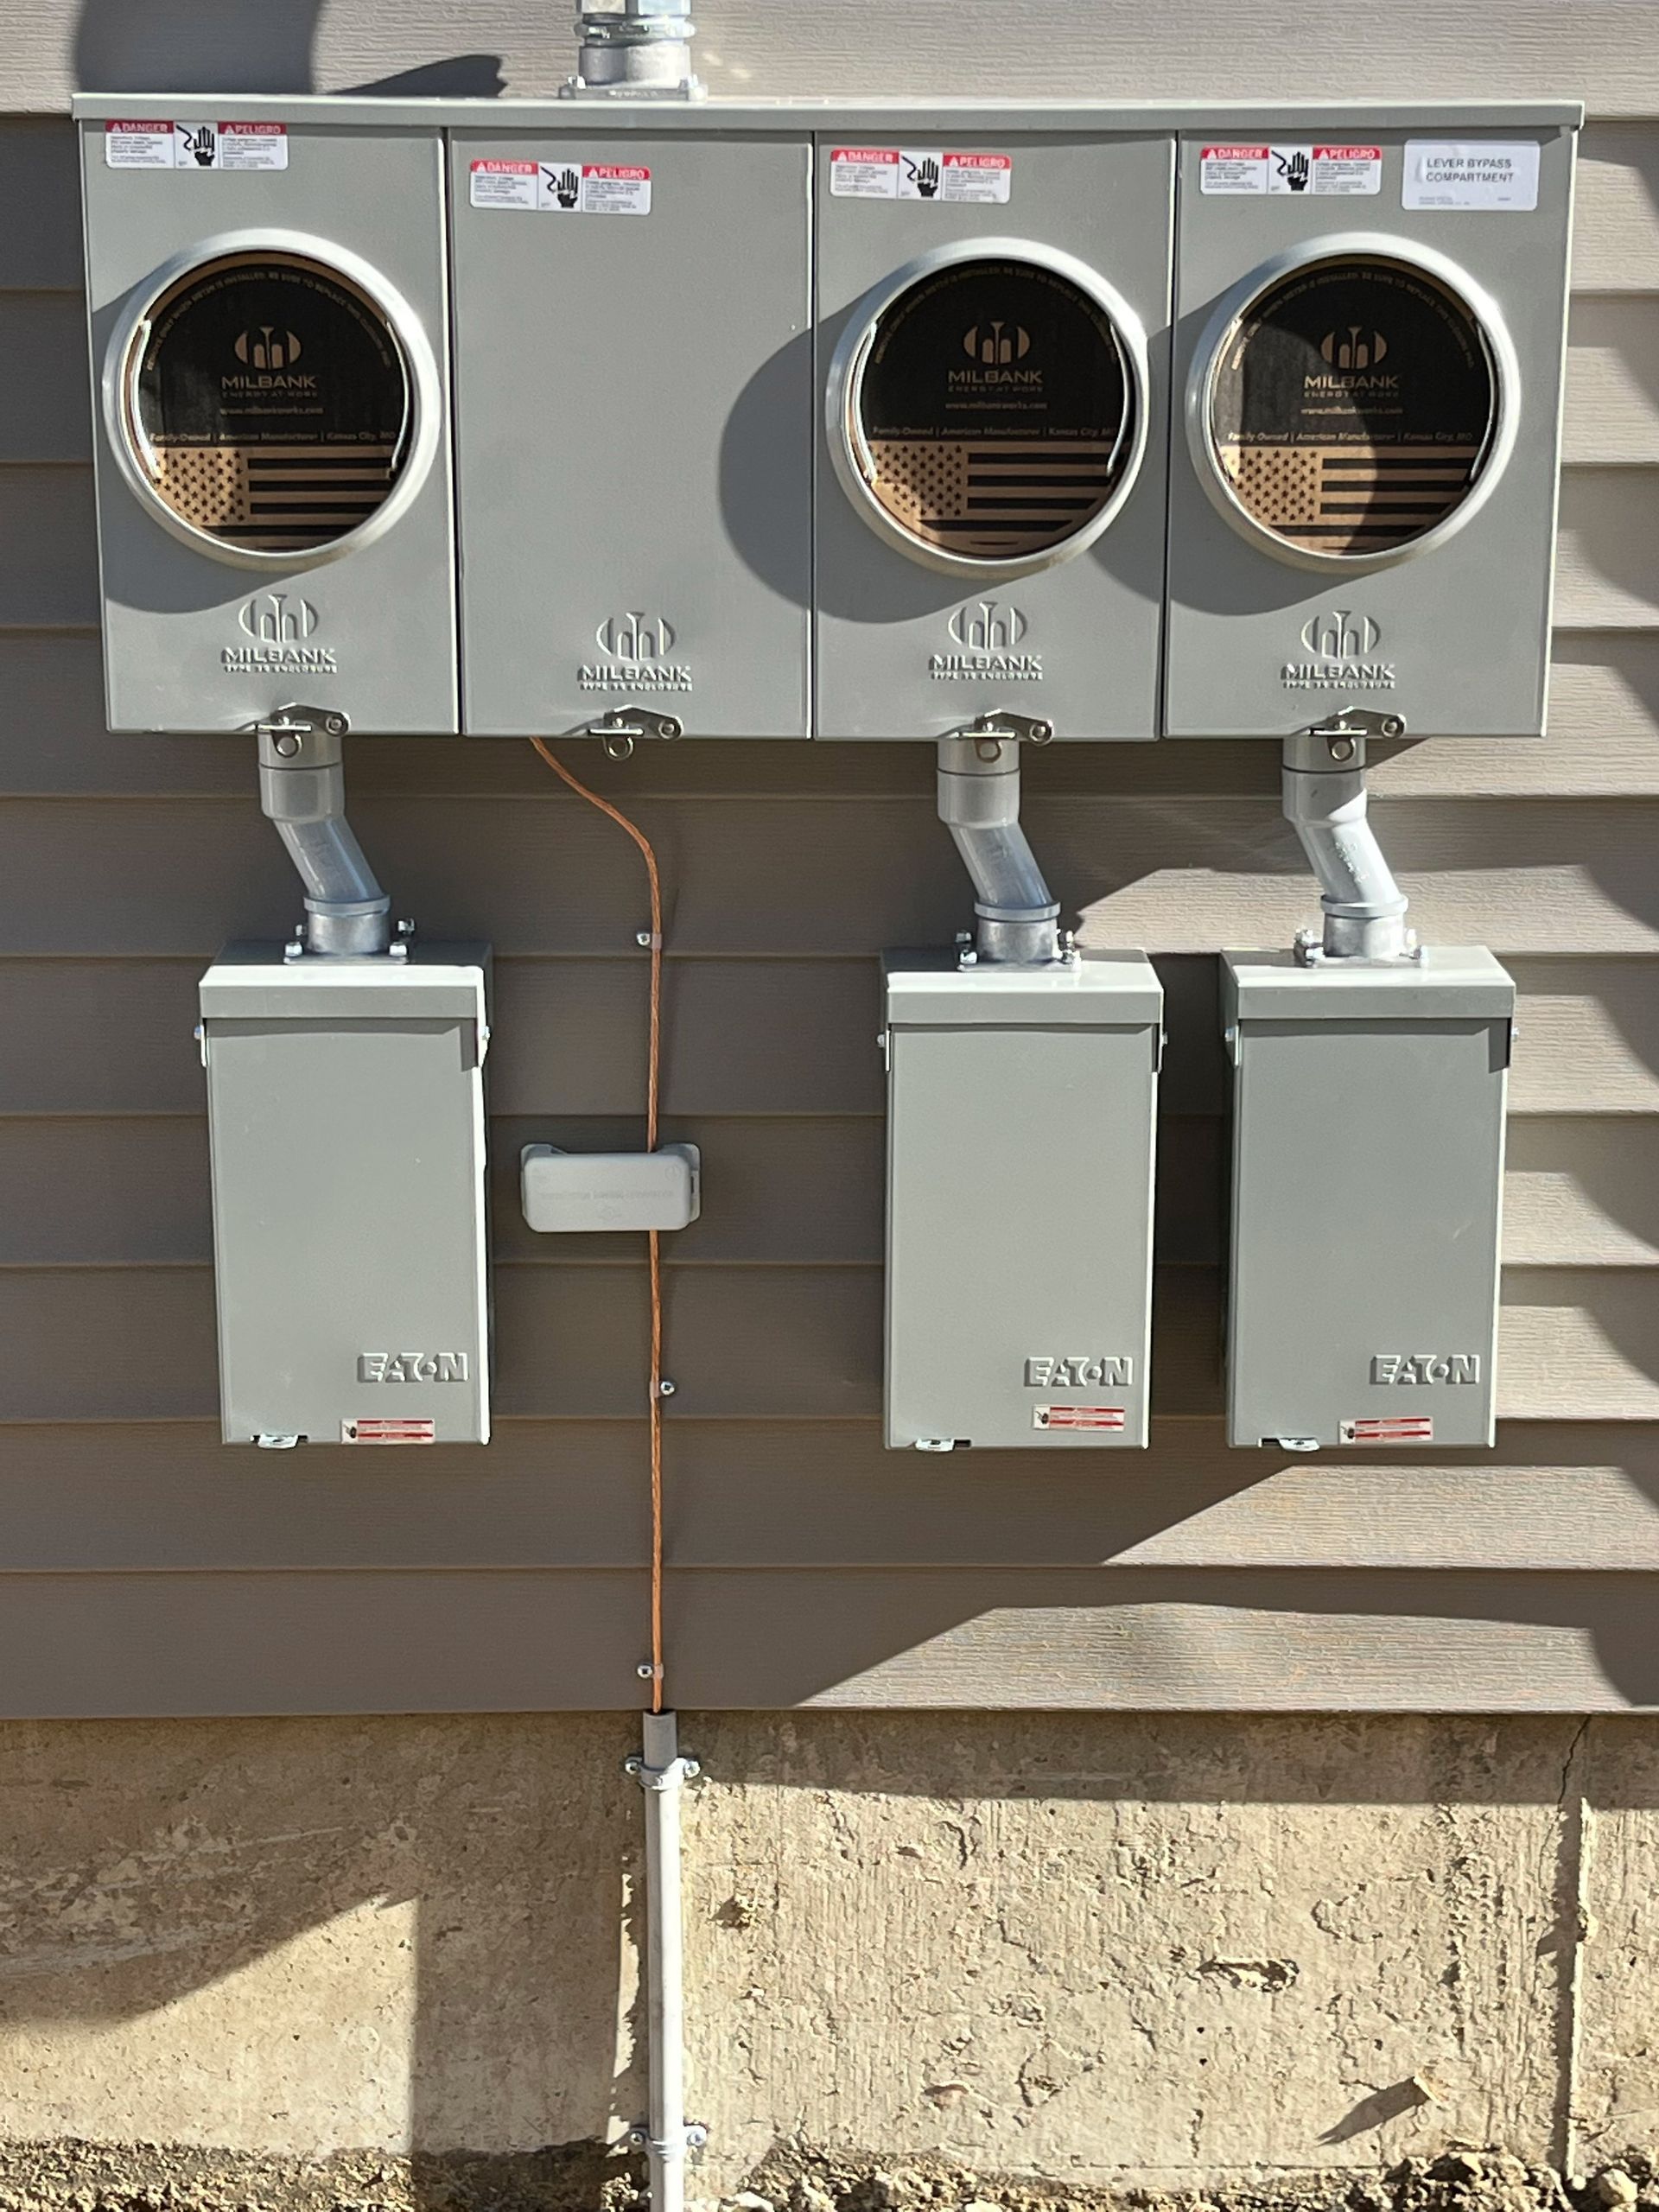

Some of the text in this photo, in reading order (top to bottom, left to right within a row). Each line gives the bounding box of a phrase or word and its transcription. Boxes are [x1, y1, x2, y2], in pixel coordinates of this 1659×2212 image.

[122, 122, 168, 133] DANGER
[234, 123, 281, 135] PELIGRO
[849, 151, 893, 162] DANGER
[1217, 148, 1263, 159] DANGER
[1329, 148, 1376, 160] PELIGRO
[486, 162, 532, 173] DANGER
[959, 156, 1005, 168] PELIGRO
[1427, 157, 1512, 169] LEVER BYPASS
[599, 167, 645, 180] PELIGRO
[1426, 172, 1514, 183] COMPARTMENT
[221, 376, 316, 390] MILBANK
[949, 370, 1043, 384] MILBANK
[1304, 375, 1400, 390] MILBANK
[327, 432, 358, 442] Kansas
[1048, 427, 1078, 436] Kansas
[220, 646, 338, 664] MILBANK
[928, 653, 1044, 671] MILBANK
[577, 664, 694, 683] MILBANK
[1280, 663, 1397, 681] MILBANK
[357, 1351, 470, 1383] EATON
[1023, 1356, 1135, 1388] EATON
[1369, 1354, 1481, 1385] EATON
